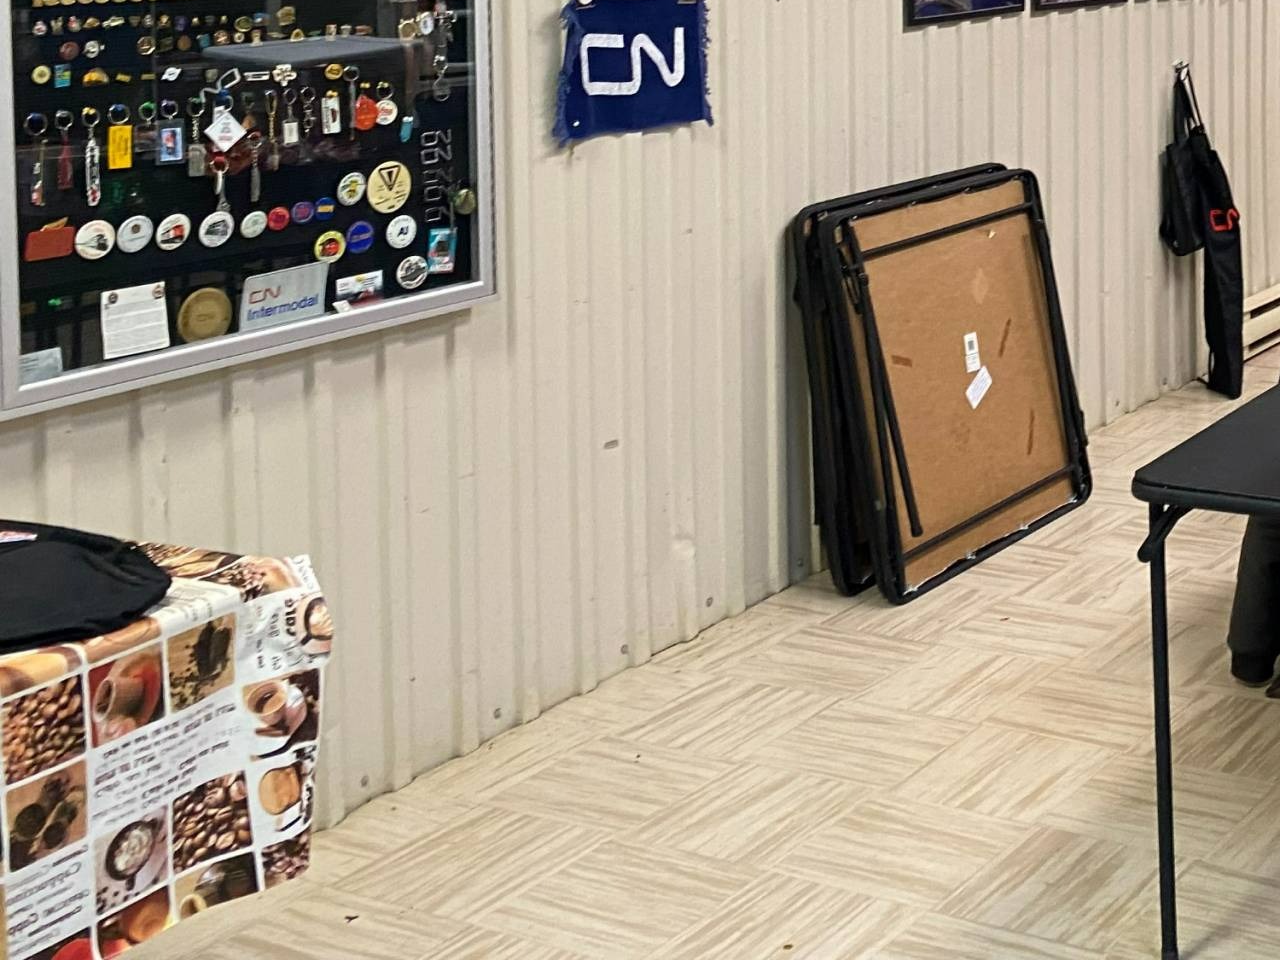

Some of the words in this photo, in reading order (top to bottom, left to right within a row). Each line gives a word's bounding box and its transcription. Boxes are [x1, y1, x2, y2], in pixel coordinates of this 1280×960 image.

[580, 26, 684, 96] CN
[247, 293, 319, 322] Intermodal
[249, 285, 281, 305] CN
